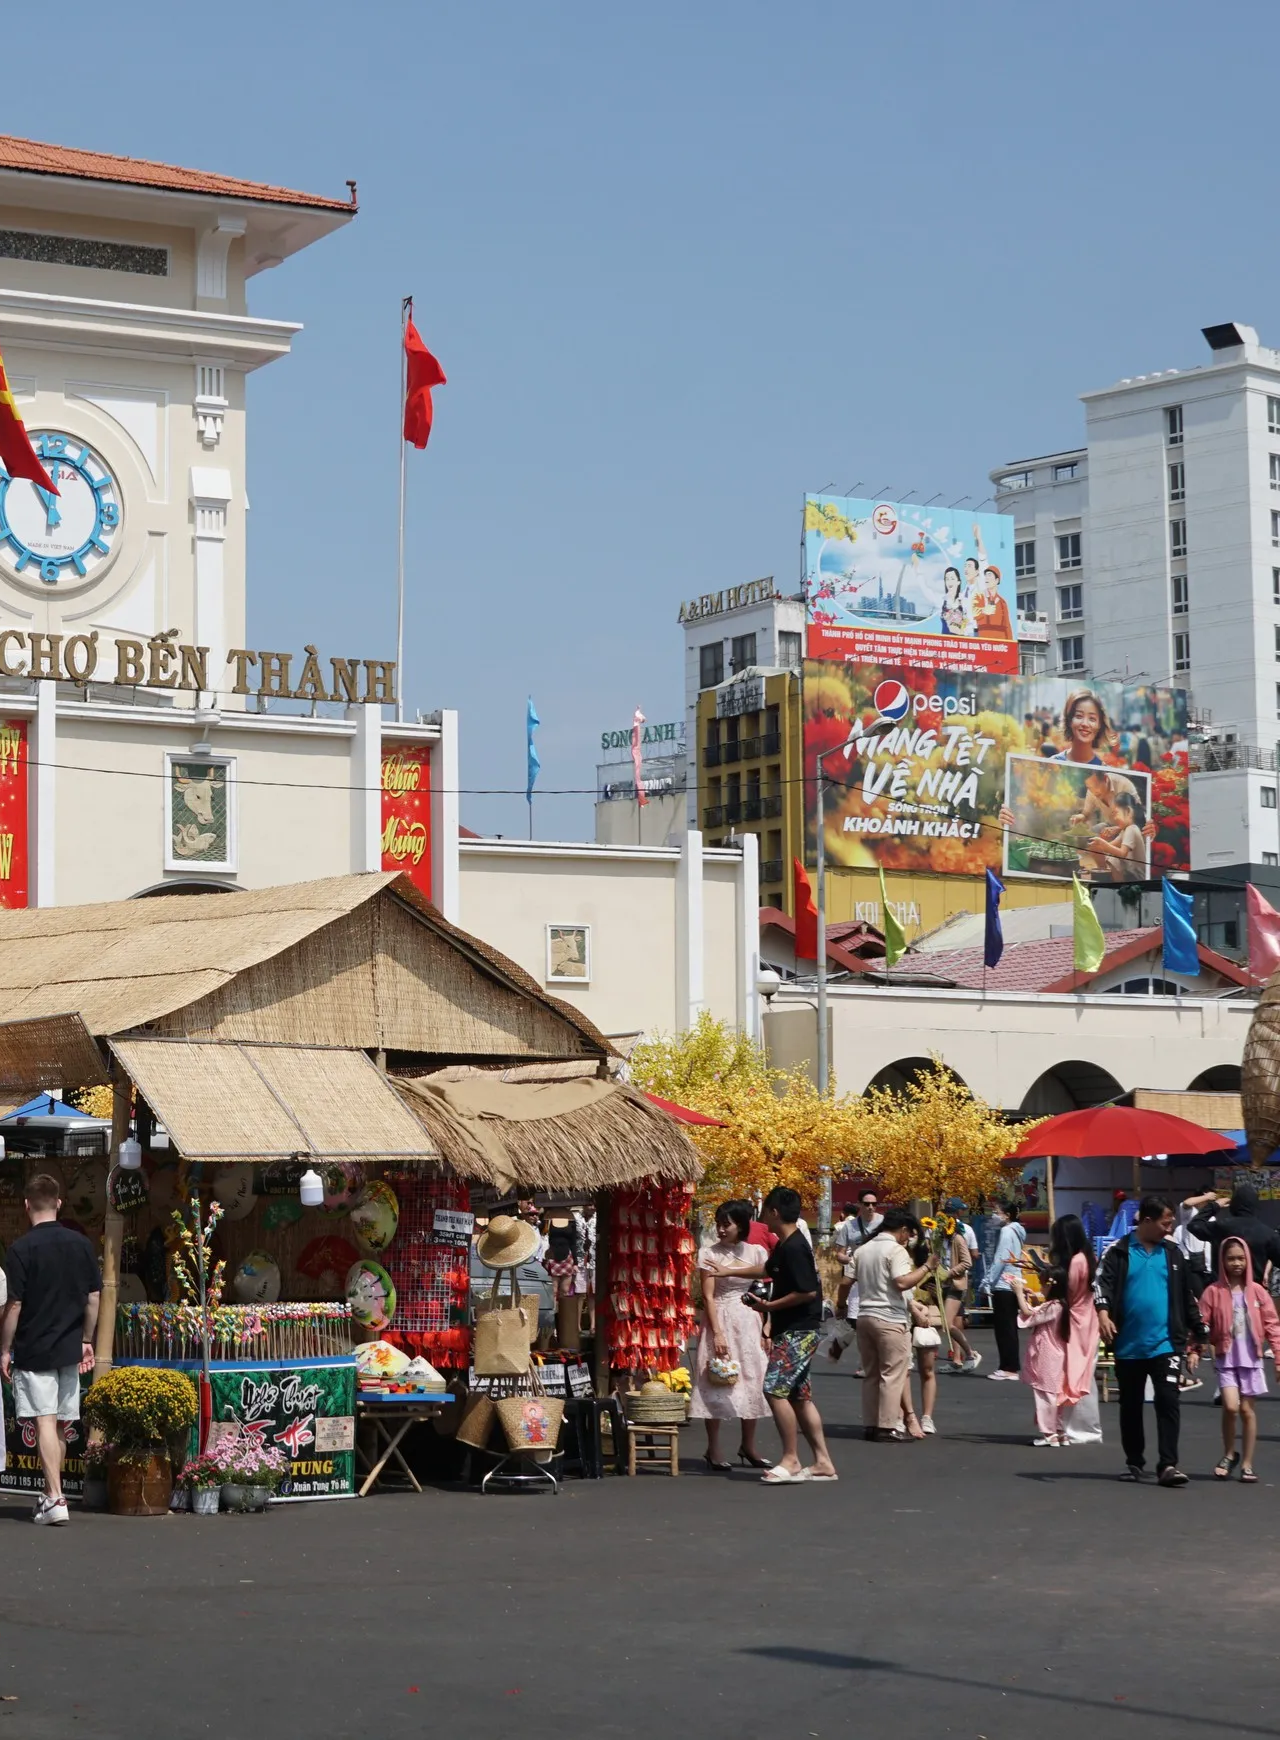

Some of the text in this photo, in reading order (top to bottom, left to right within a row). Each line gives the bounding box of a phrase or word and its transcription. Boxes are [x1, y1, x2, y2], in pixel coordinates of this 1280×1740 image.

[100, 503, 119, 526] 3
[41, 558, 60, 581] 6
[726, 576, 778, 610] HOTEL
[114, 628, 210, 691] BẾN
[227, 644, 397, 704] THÀNH
[912, 693, 976, 717] pepsi
[641, 723, 676, 743] ANH
[843, 717, 996, 766] MANG TẾT
[862, 758, 985, 809] VỀ NHÀ
[888, 799, 918, 814] SỐNG
[843, 814, 920, 836] KHOẢNH
[855, 901, 879, 925] KOI
[293, 1481, 312, 1492] Xuân
[312, 1481, 329, 1492] Tung
